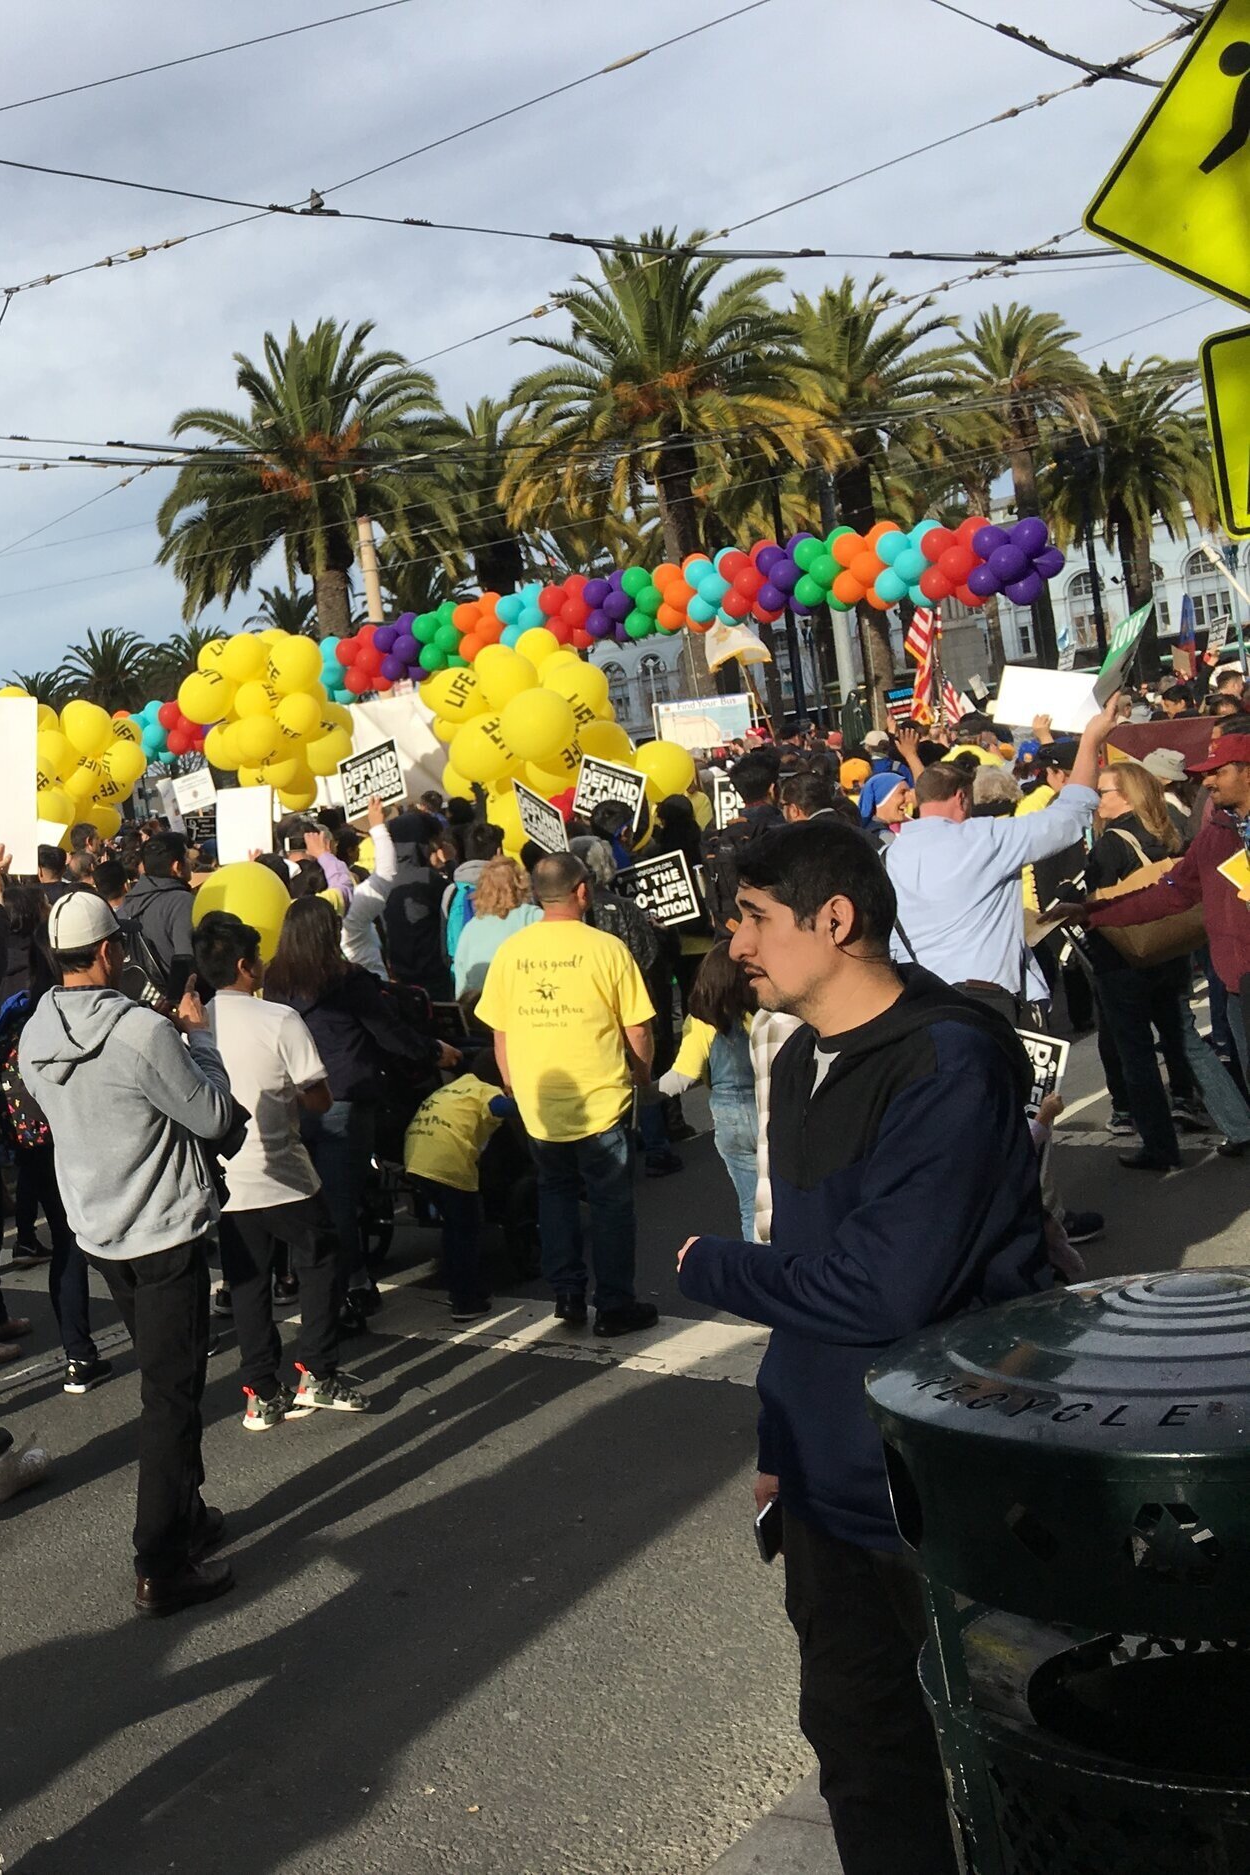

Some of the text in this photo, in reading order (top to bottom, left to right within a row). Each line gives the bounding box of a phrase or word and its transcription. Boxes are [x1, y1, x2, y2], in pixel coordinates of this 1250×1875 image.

[1112, 611, 1144, 653] LOVE
[445, 673, 476, 708] LIFE
[677, 696, 737, 711] Find Your Bus
[77, 756, 102, 777] LIFE
[343, 751, 397, 790] DEFUND
[99, 780, 120, 797] IFE
[345, 767, 400, 804] PLANNED
[582, 768, 640, 801] DEFUND
[626, 878, 648, 895] AM
[650, 867, 681, 887] THE
[634, 880, 690, 909] O-LIFE
[649, 897, 692, 918] RATION
[517, 954, 583, 974] Life is good!
[912, 1374, 1199, 1427] RECYCLE
